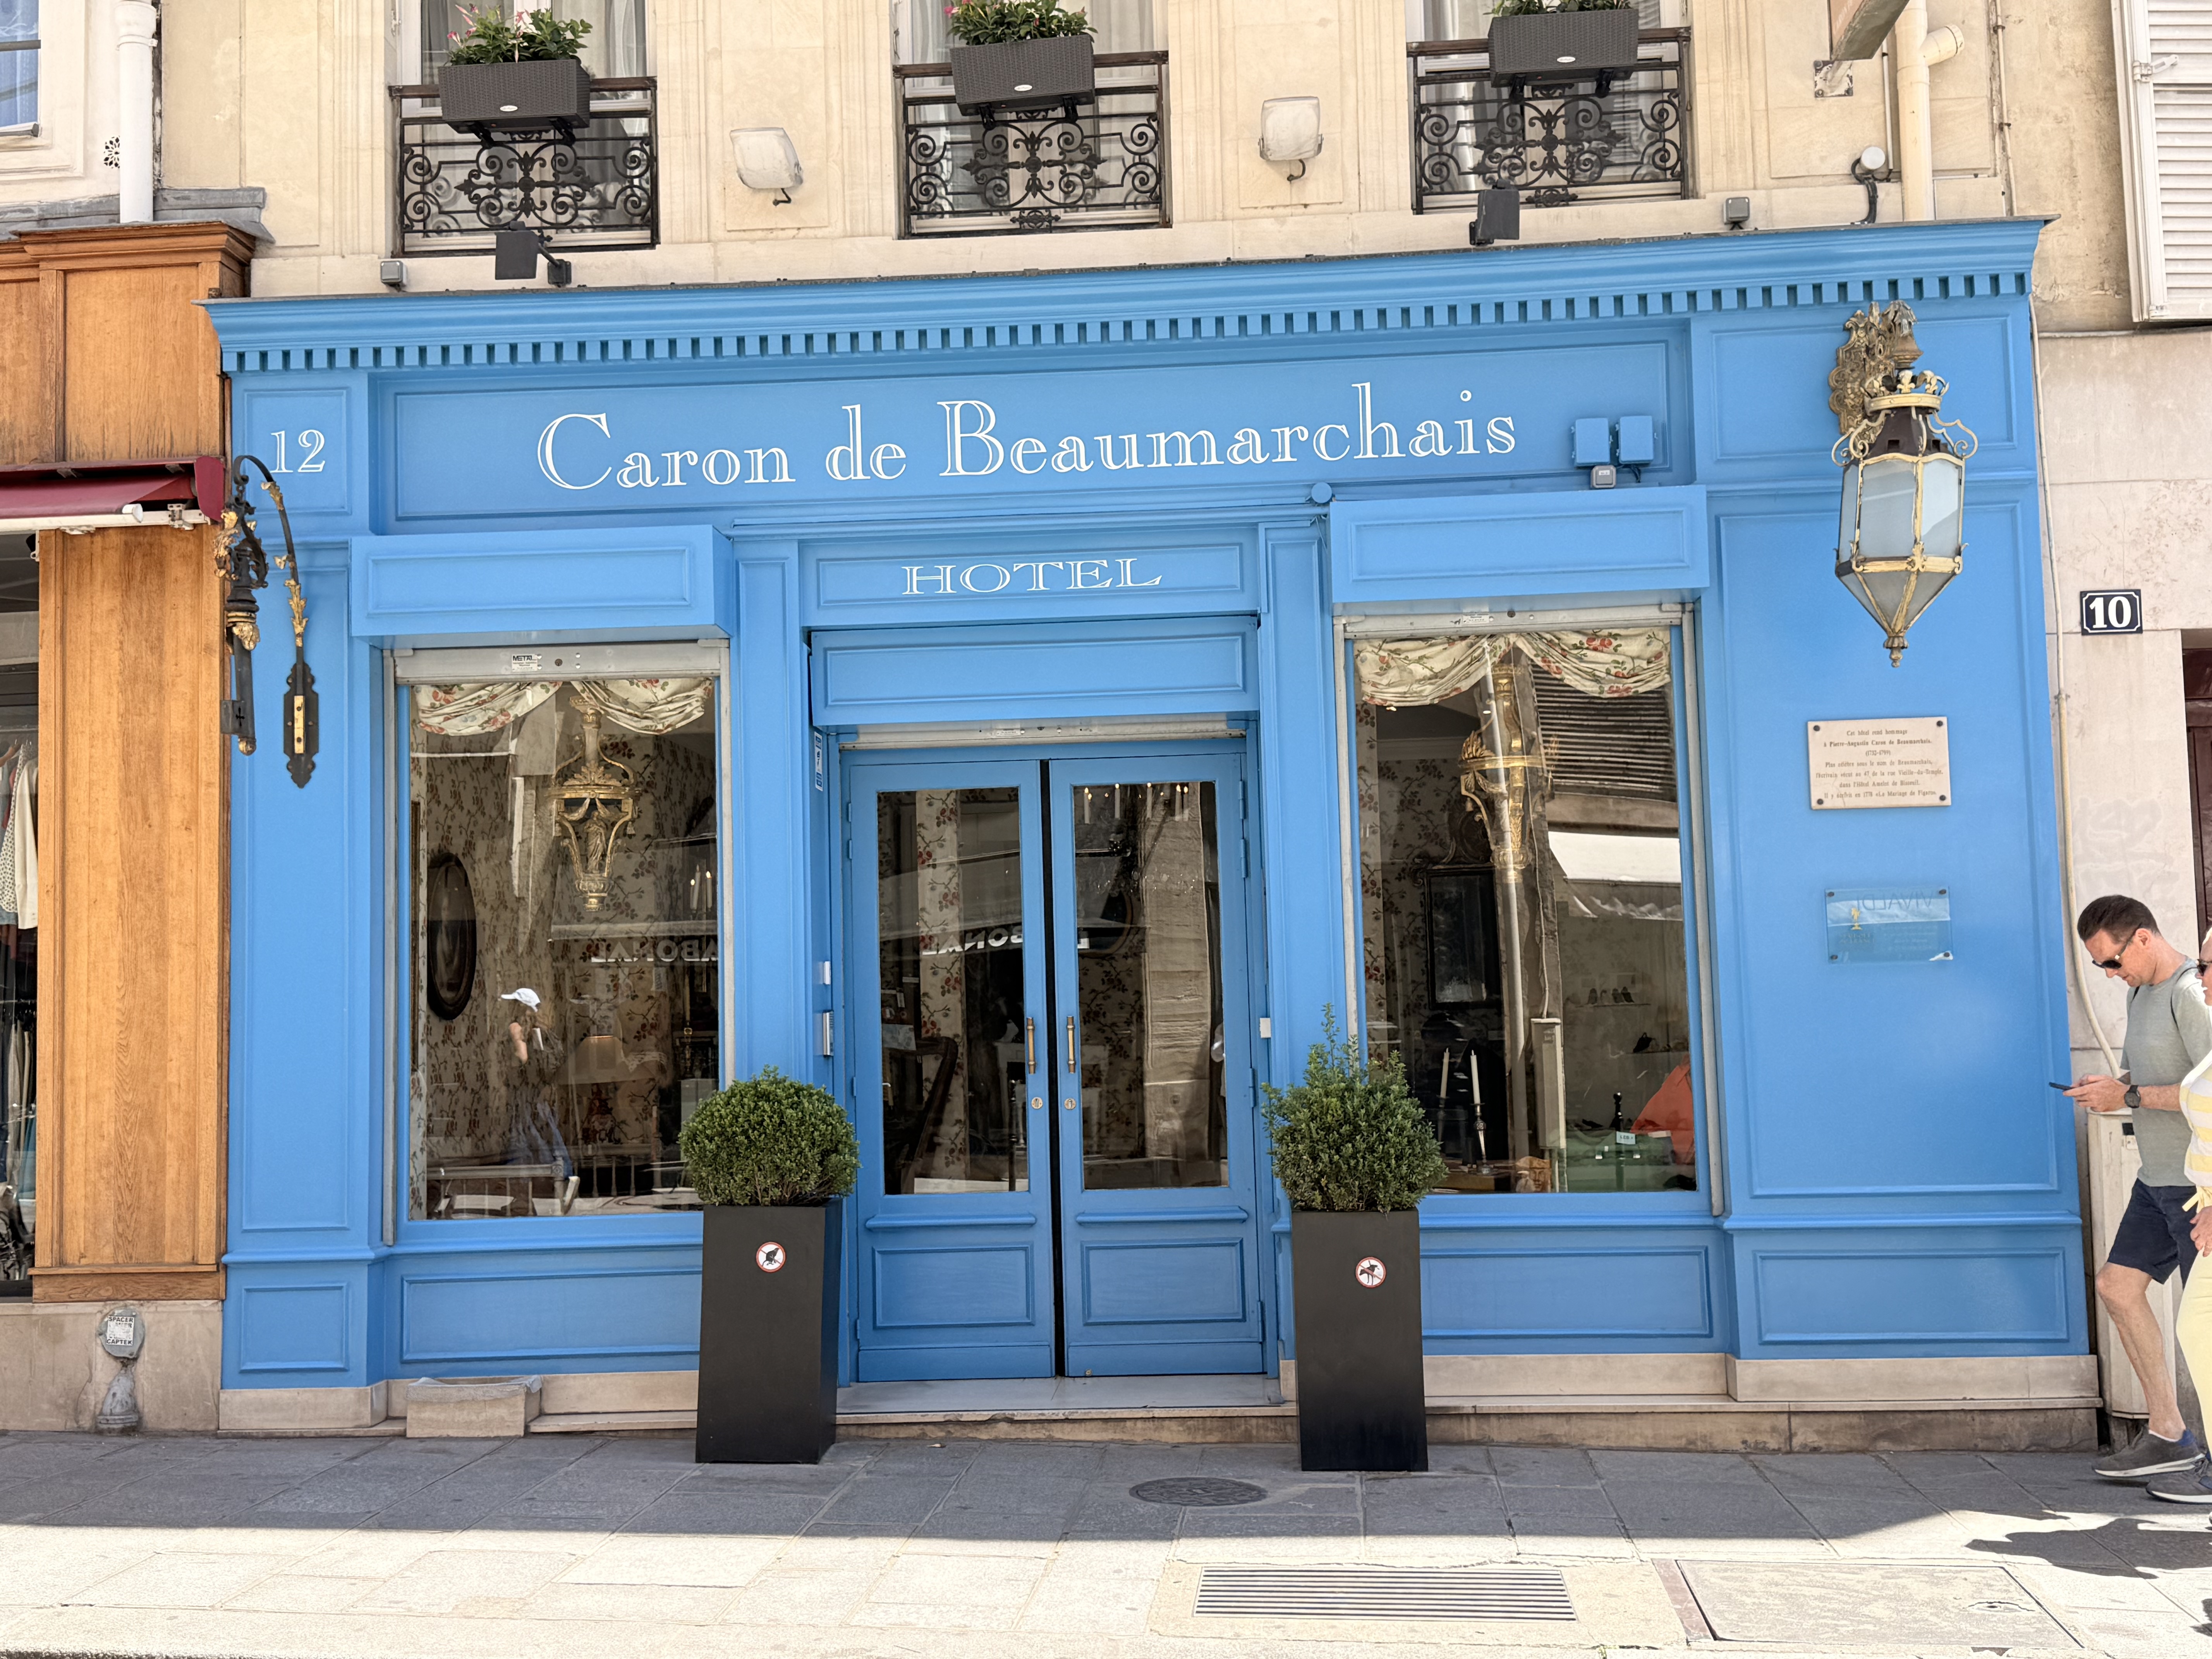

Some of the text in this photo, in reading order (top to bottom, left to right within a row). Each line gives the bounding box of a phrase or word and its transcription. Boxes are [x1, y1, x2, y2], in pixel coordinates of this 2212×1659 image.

[270, 429, 325, 472] 12
[538, 382, 1516, 489] Caron de Beaumarchais
[902, 558, 1162, 594] HOTEL
[2089, 596, 2131, 628] 10
